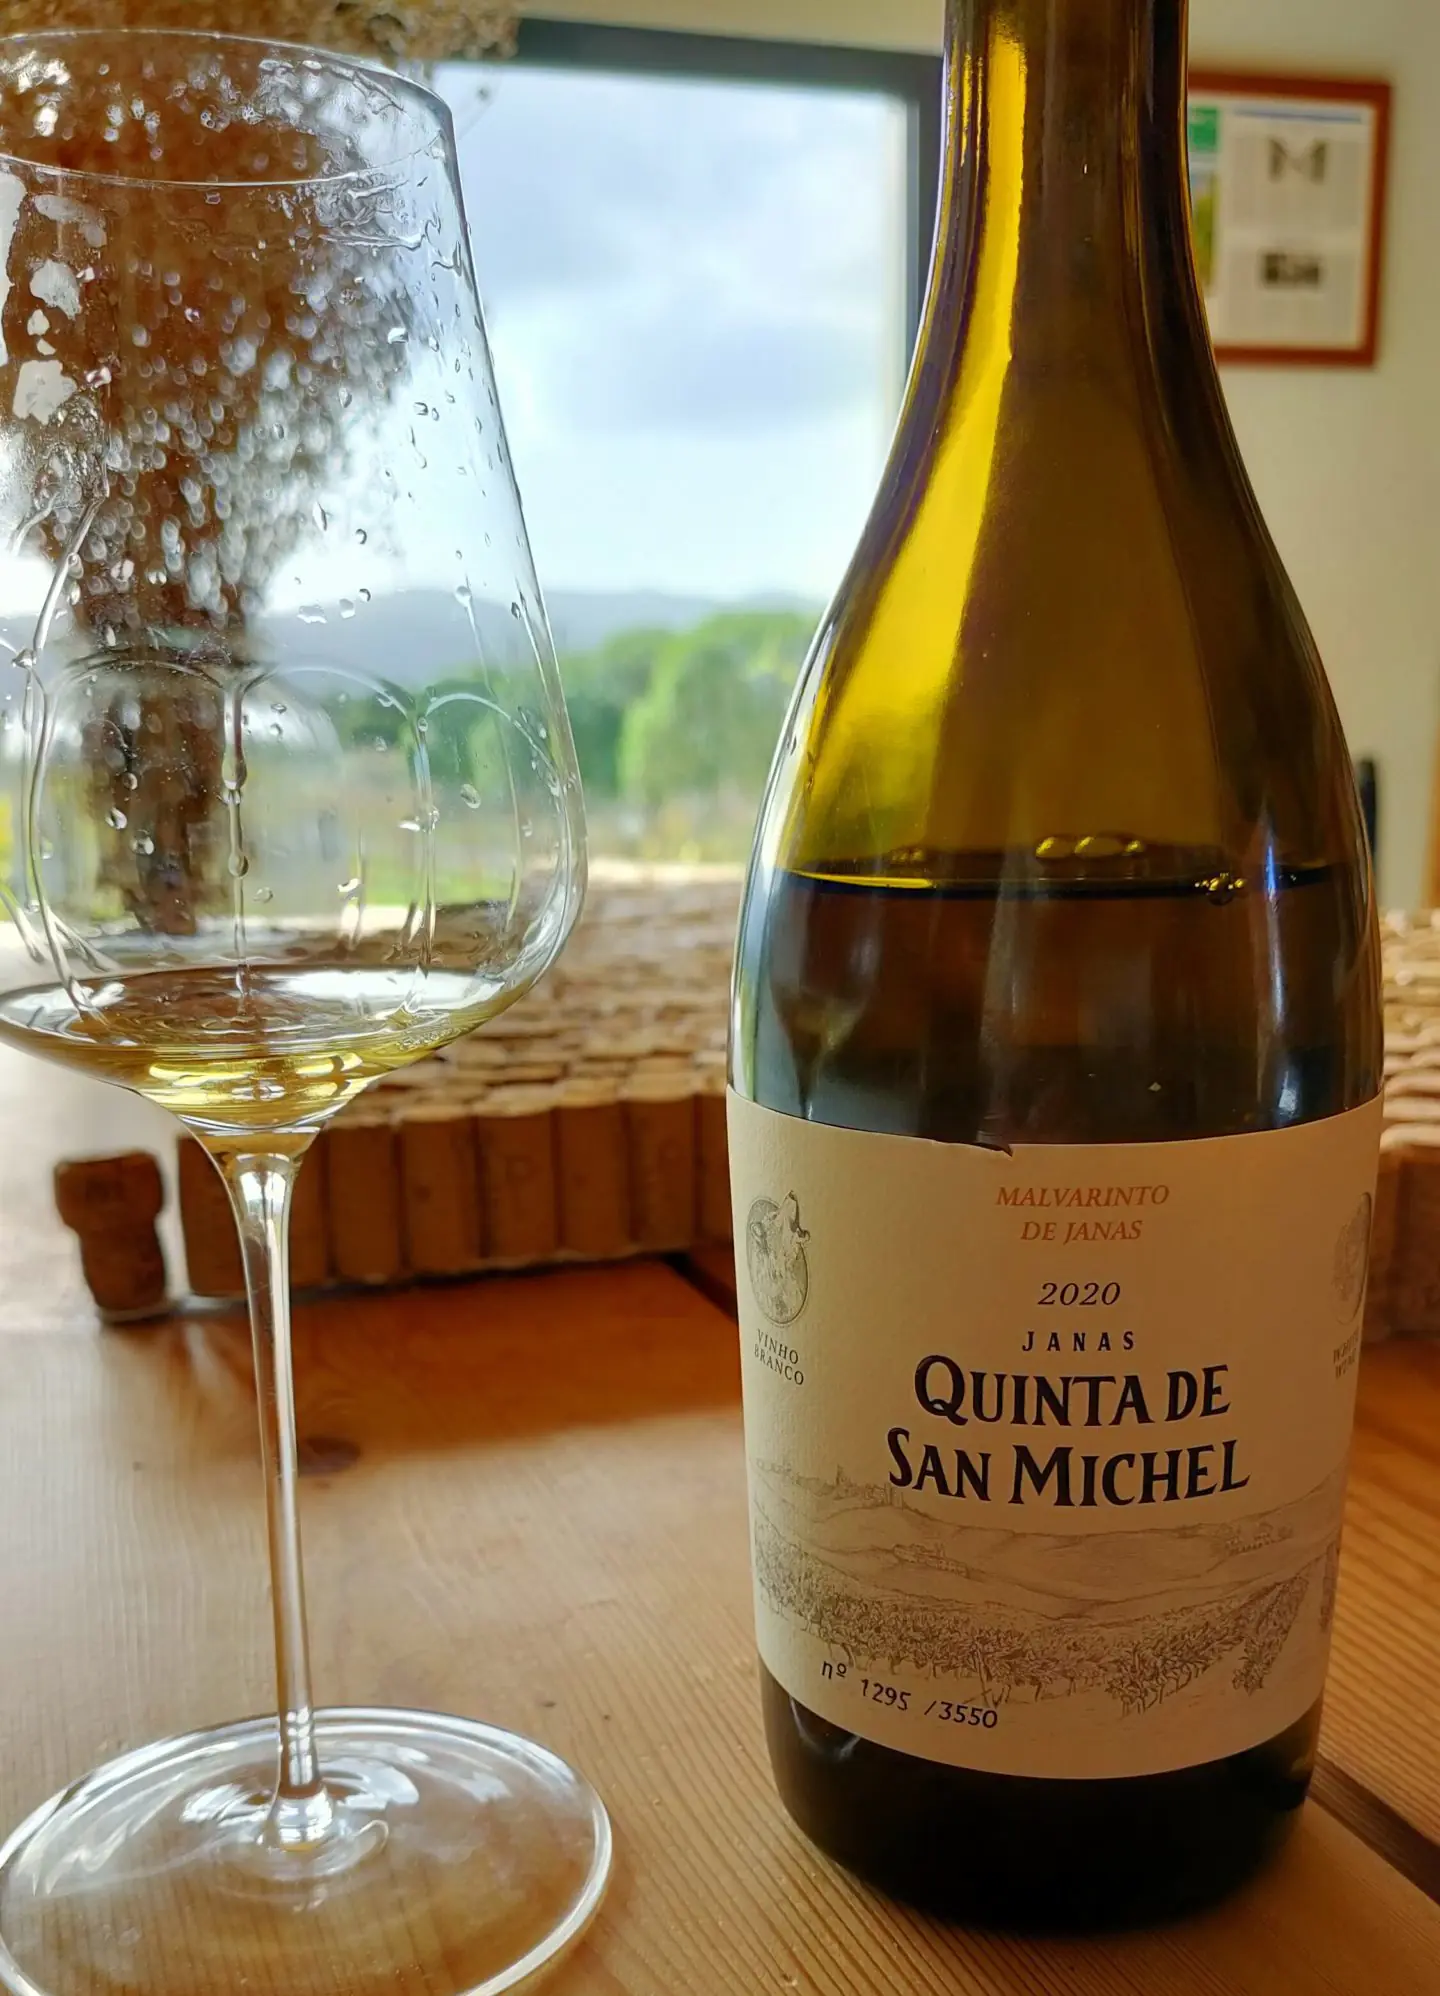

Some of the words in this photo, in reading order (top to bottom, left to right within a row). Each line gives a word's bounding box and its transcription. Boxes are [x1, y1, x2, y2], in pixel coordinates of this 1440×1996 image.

[995, 1184, 1170, 1207] MALVARINTO
[1020, 1221, 1056, 1241] DE
[1063, 1219, 1143, 1246] JANAS
[1037, 1282, 1121, 1306] 2020
[757, 1329, 799, 1365] VINHO
[1021, 1330, 1135, 1352] JANAS
[754, 1344, 804, 1386] BRANCO
[914, 1354, 1156, 1427] QUINTA
[1163, 1364, 1231, 1423] DE
[886, 1427, 992, 1502] SAN
[1007, 1439, 1252, 1507] MICHEL
[860, 1678, 912, 1711] 1295
